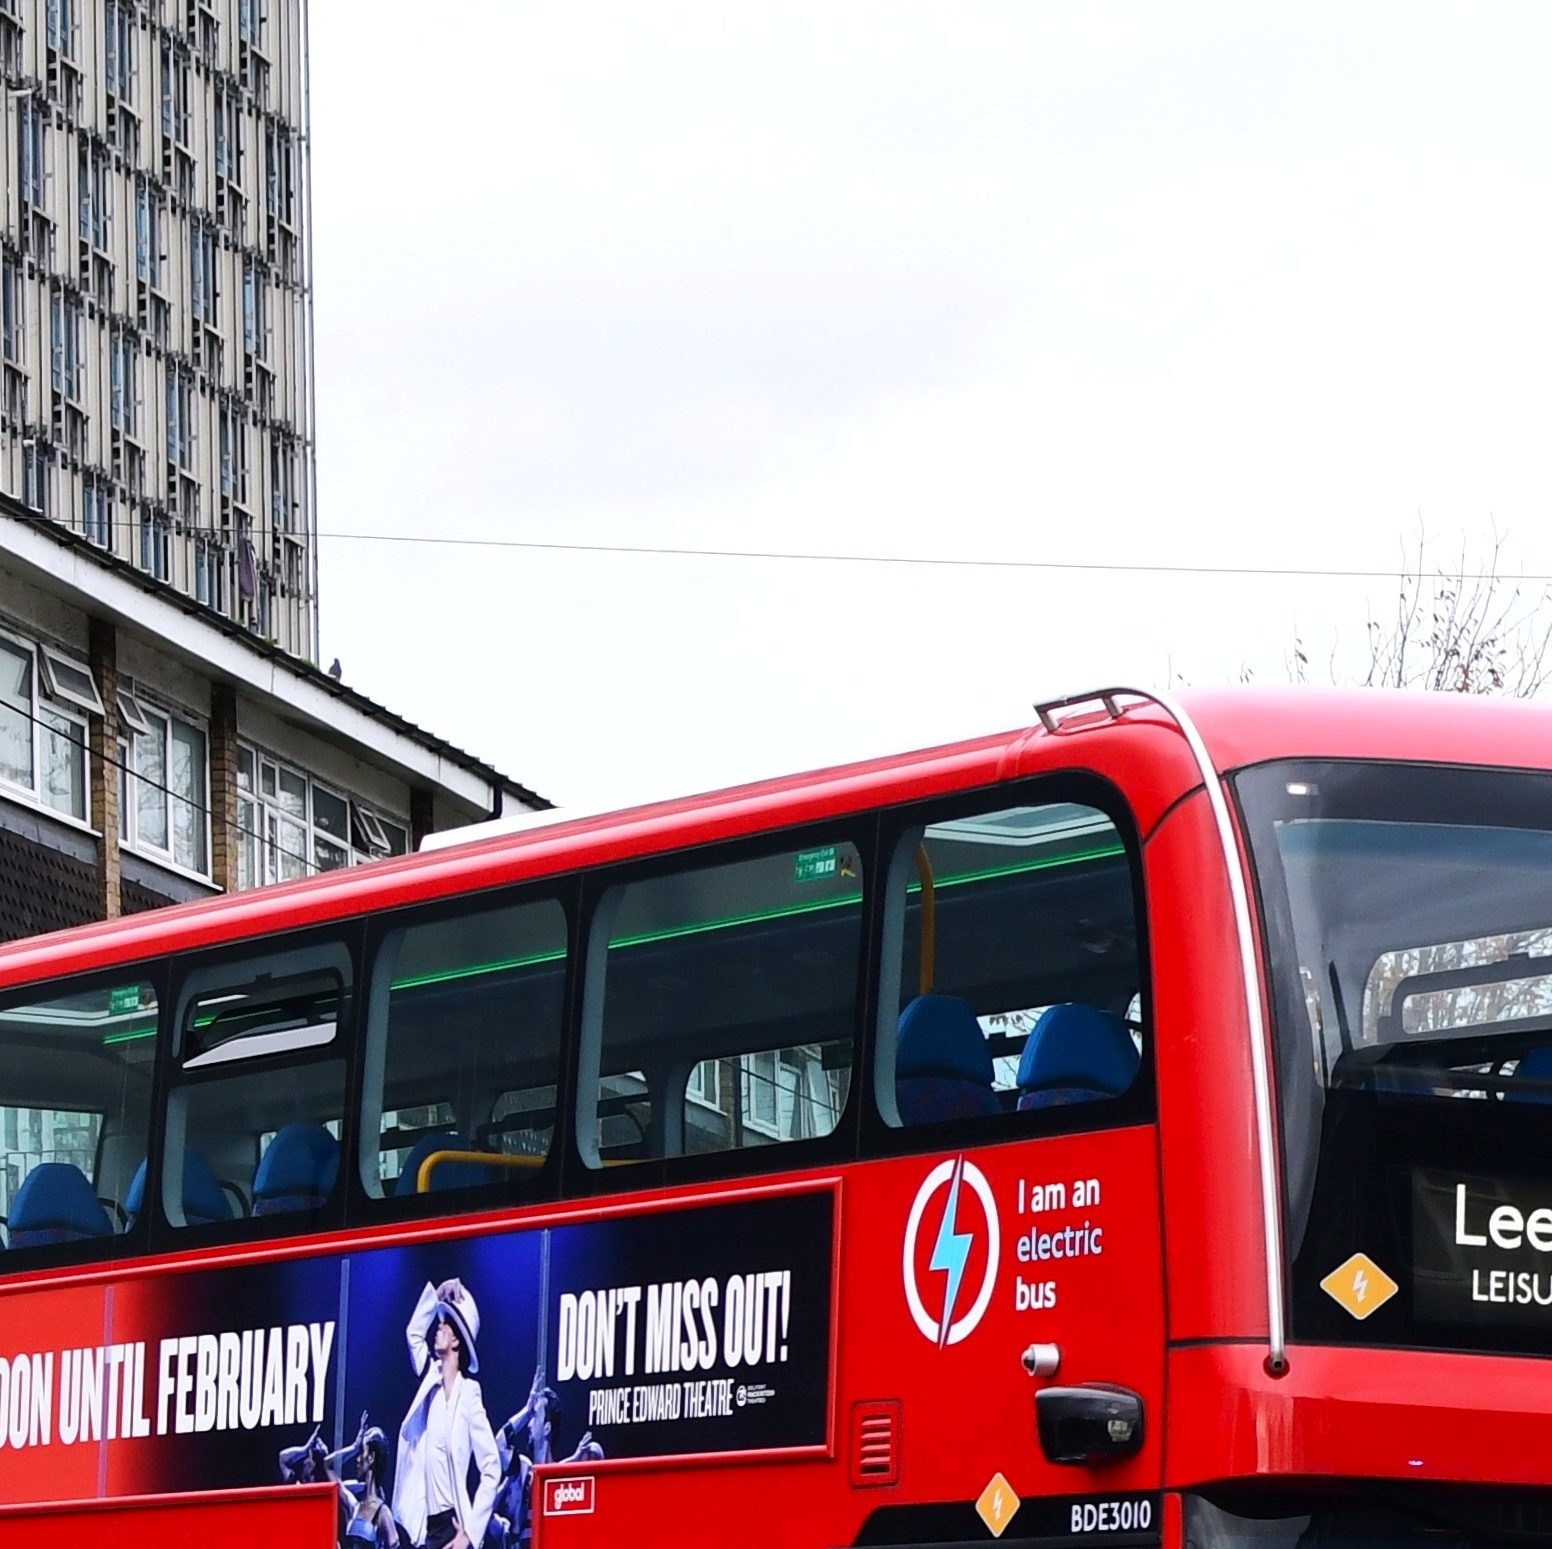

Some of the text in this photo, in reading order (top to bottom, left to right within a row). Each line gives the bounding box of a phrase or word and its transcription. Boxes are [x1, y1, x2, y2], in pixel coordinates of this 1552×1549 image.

[1018, 1178, 1100, 1214] I am an
[1017, 1220, 1103, 1262] electric
[1015, 1276, 1056, 1311] bus
[557, 1270, 791, 1381] DON'T MISS OUT!
[58, 1341, 151, 1444] UNTIL
[156, 1321, 335, 1435] FEBRUARY
[588, 1378, 734, 1426] PRINCE EDWARD THEATRE
[554, 1482, 585, 1510] global
[1071, 1500, 1151, 1532] BDE3010
